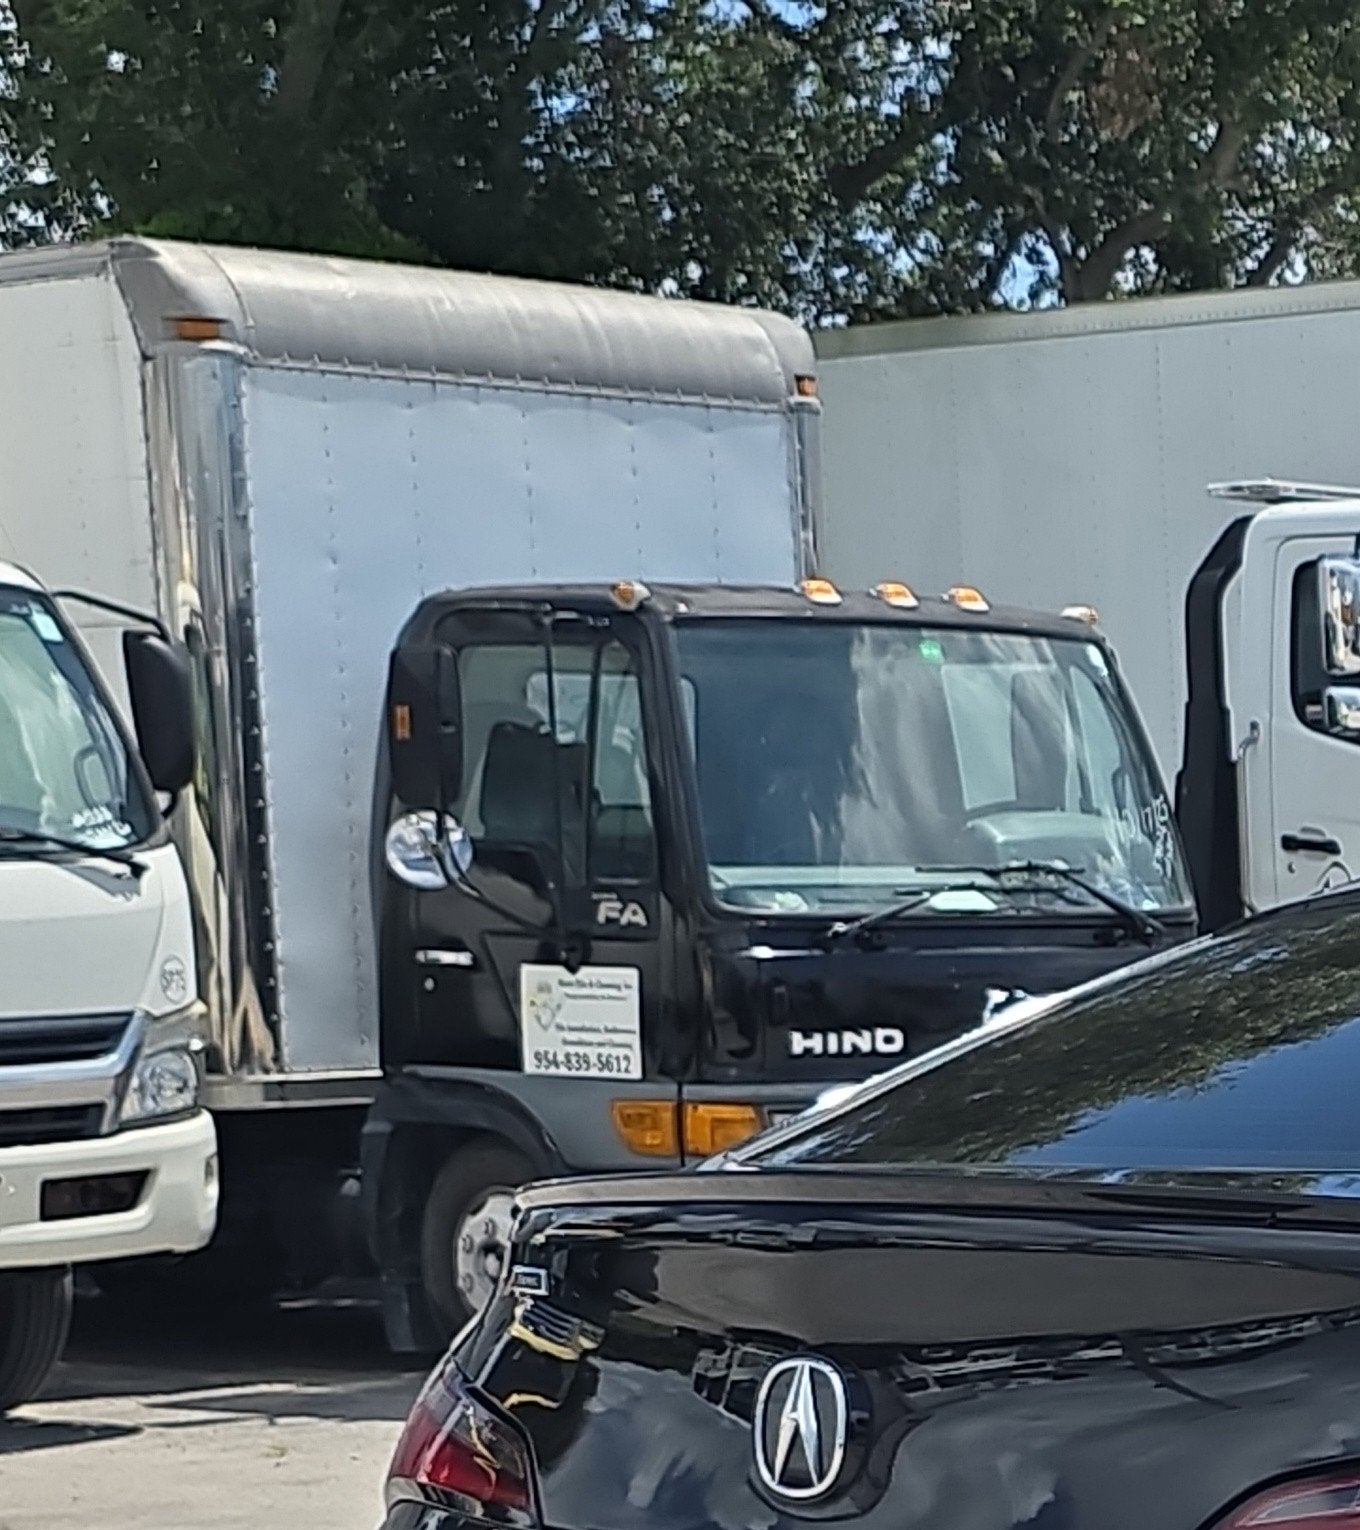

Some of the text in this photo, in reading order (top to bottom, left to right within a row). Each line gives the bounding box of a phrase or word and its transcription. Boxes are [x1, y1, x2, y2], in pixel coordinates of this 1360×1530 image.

[597, 900, 648, 927] FA
[788, 1026, 905, 1056] HINO
[533, 1049, 632, 1075] 954-839-5612
